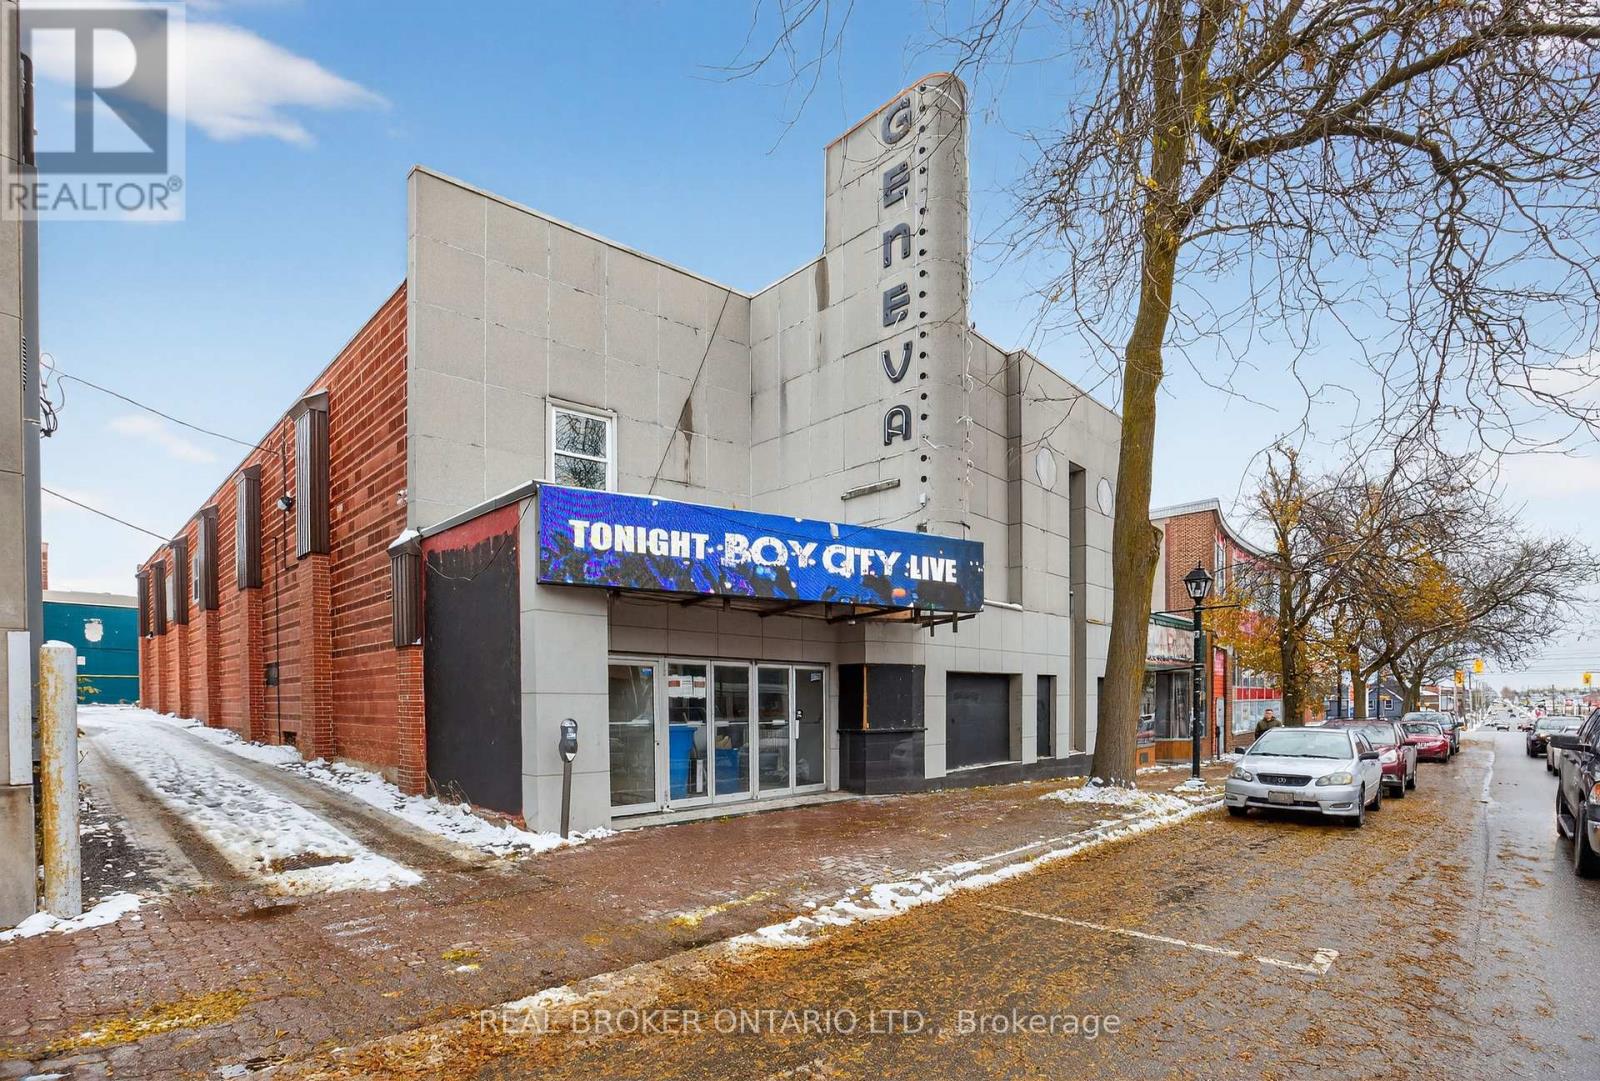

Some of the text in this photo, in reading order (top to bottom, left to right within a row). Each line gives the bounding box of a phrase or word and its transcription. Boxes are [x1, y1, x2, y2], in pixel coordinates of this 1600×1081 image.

[880, 97, 913, 447] GENEVA
[568, 519, 958, 583] TONIGHT BOY CITY LIVE
